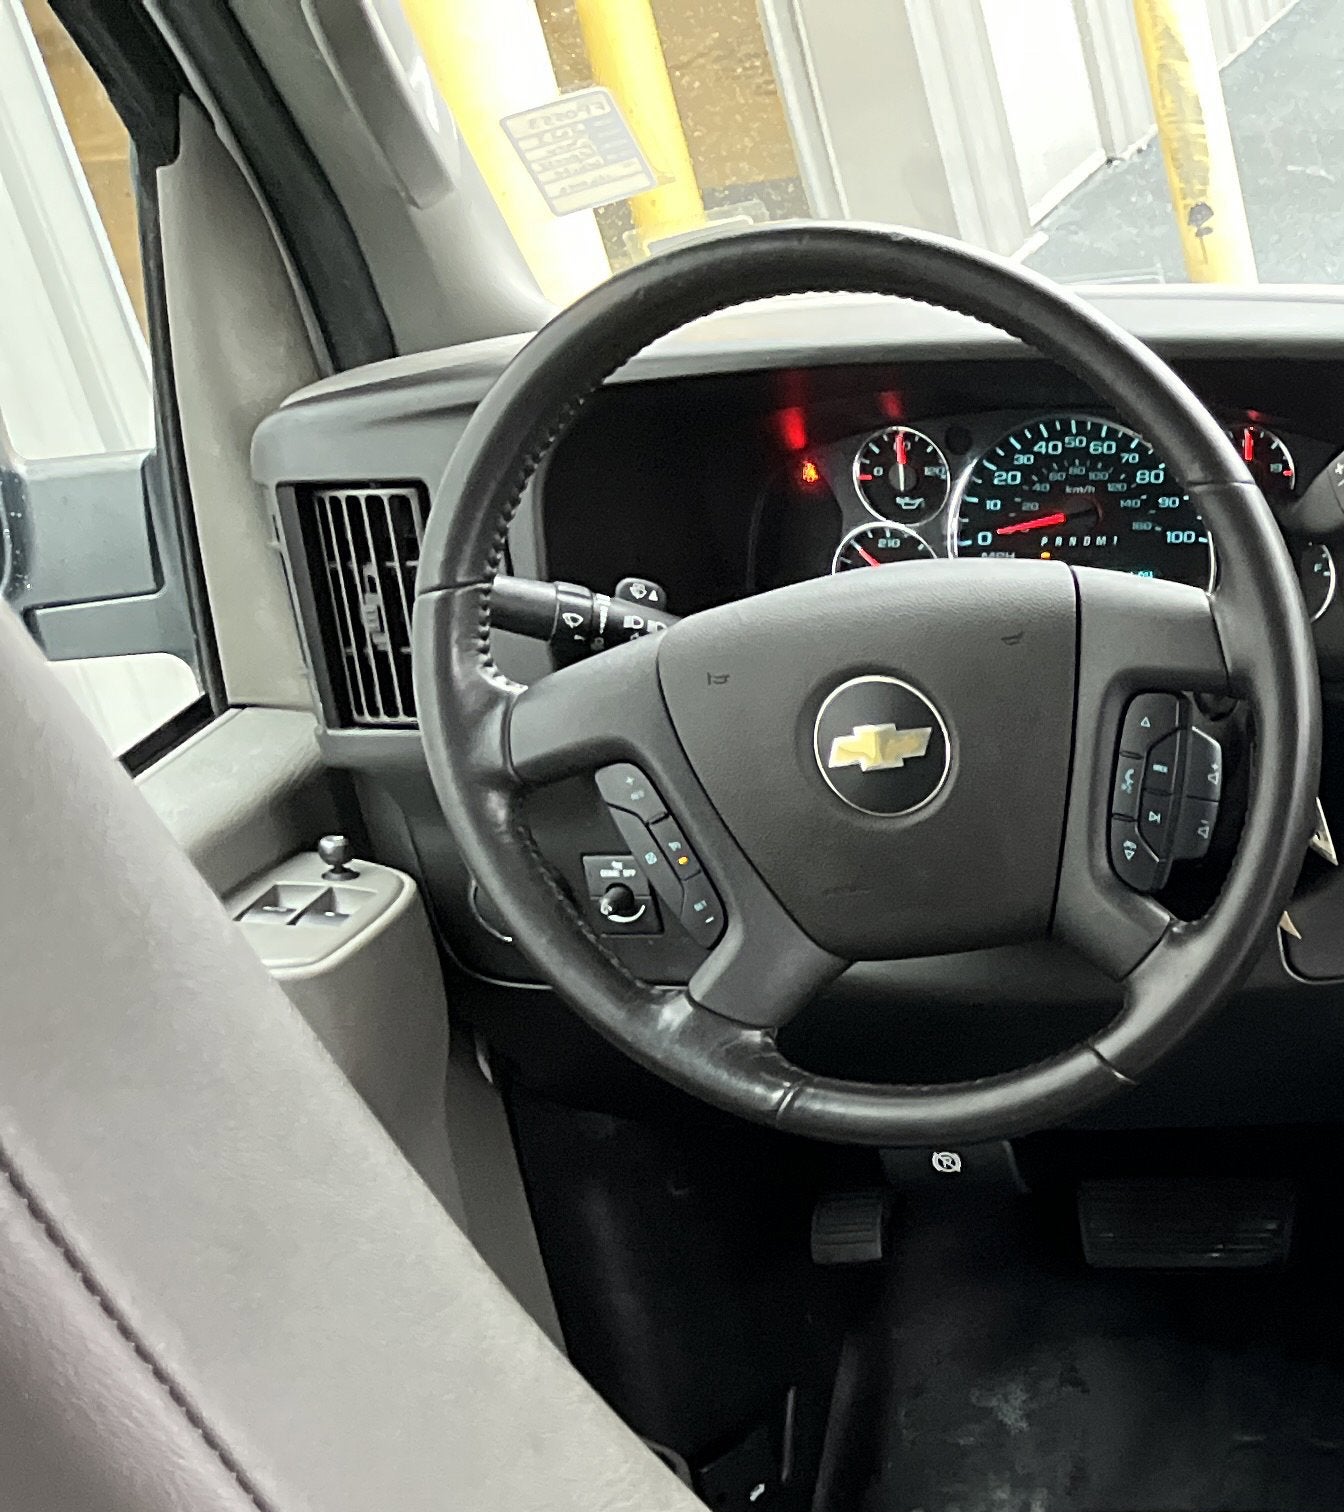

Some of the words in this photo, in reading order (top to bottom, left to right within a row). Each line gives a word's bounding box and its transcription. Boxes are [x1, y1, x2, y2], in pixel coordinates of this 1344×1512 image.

[1064, 436, 1087, 448] 50
[1033, 441, 1062, 455] 40
[1089, 441, 1116, 455] 60
[1013, 454, 1034, 465] 30
[1120, 453, 1139, 464] 70
[873, 466, 883, 476] 0
[1088, 471, 1109, 481] 100
[1136, 469, 1164, 484] 80
[993, 471, 1021, 485] 20
[1032, 482, 1050, 492] 40
[1065, 485, 1096, 494] km/h
[986, 500, 1001, 511] 10
[1021, 502, 1039, 511] 20
[1120, 498, 1141, 508] 140
[1158, 496, 1180, 508] 90
[977, 532, 992, 545] 0
[1166, 531, 1196, 544] 100
